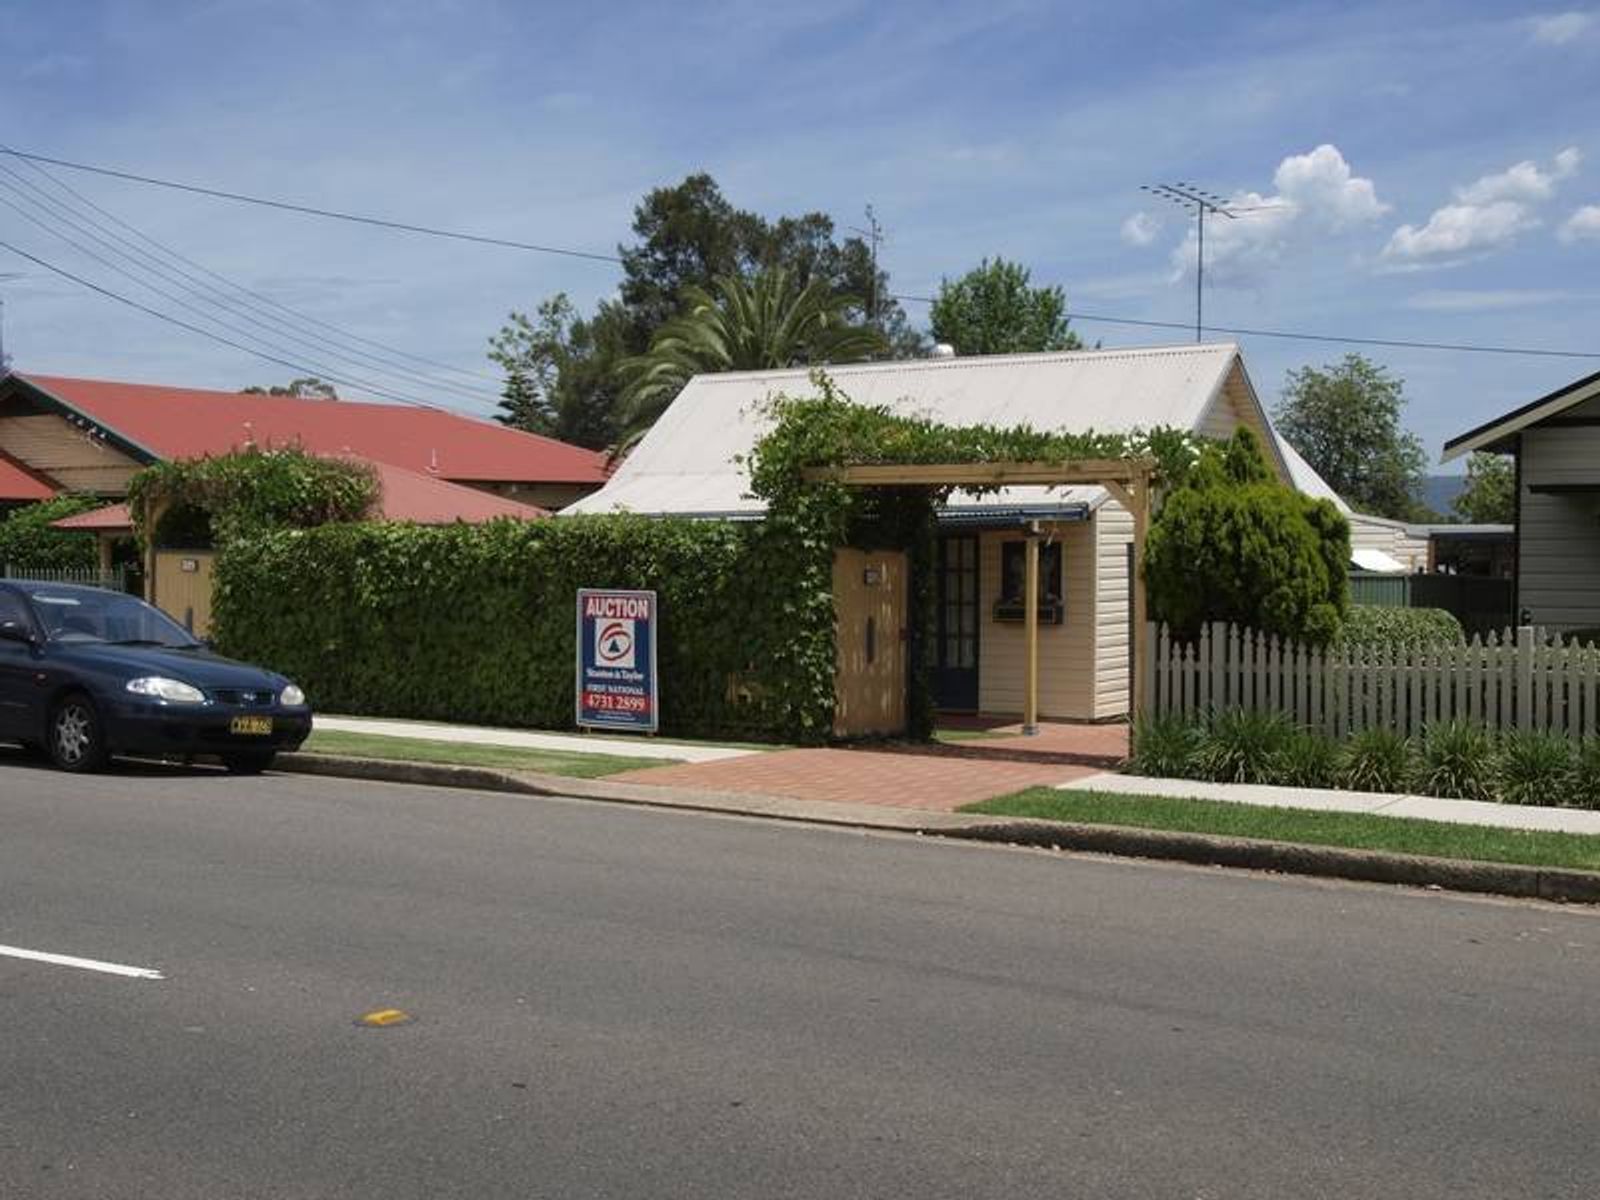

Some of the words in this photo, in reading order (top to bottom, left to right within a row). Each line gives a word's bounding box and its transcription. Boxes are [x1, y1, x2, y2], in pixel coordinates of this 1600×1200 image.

[586, 597, 649, 619] AUCTION
[607, 685, 644, 695] NATIONAL
[588, 693, 613, 708] 4731
